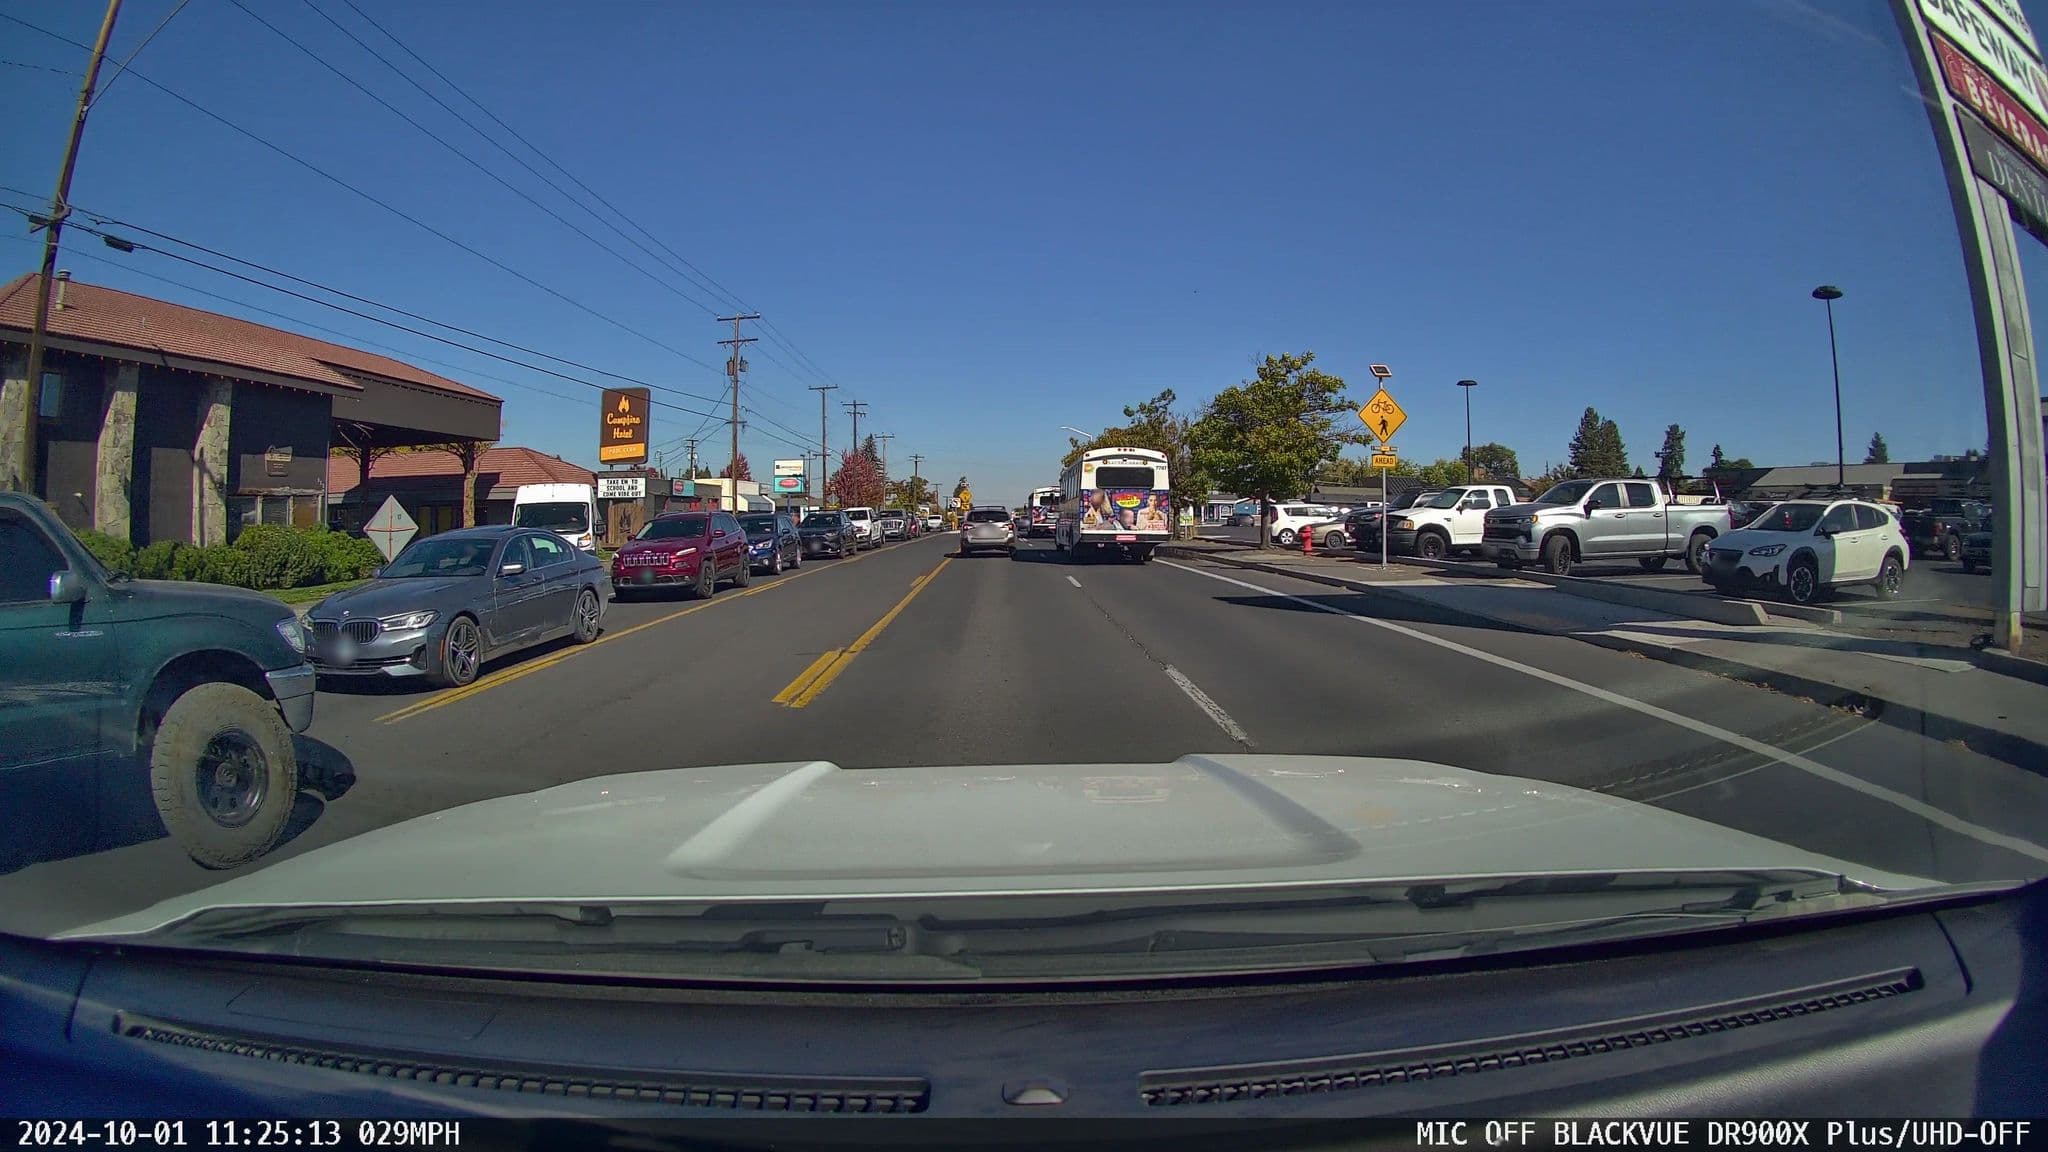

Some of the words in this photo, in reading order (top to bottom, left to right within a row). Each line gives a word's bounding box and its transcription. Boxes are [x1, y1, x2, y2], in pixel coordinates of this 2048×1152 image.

[607, 412, 641, 426] Campfire
[613, 427, 634, 439] Hotel
[1375, 457, 1394, 465] AHEAD
